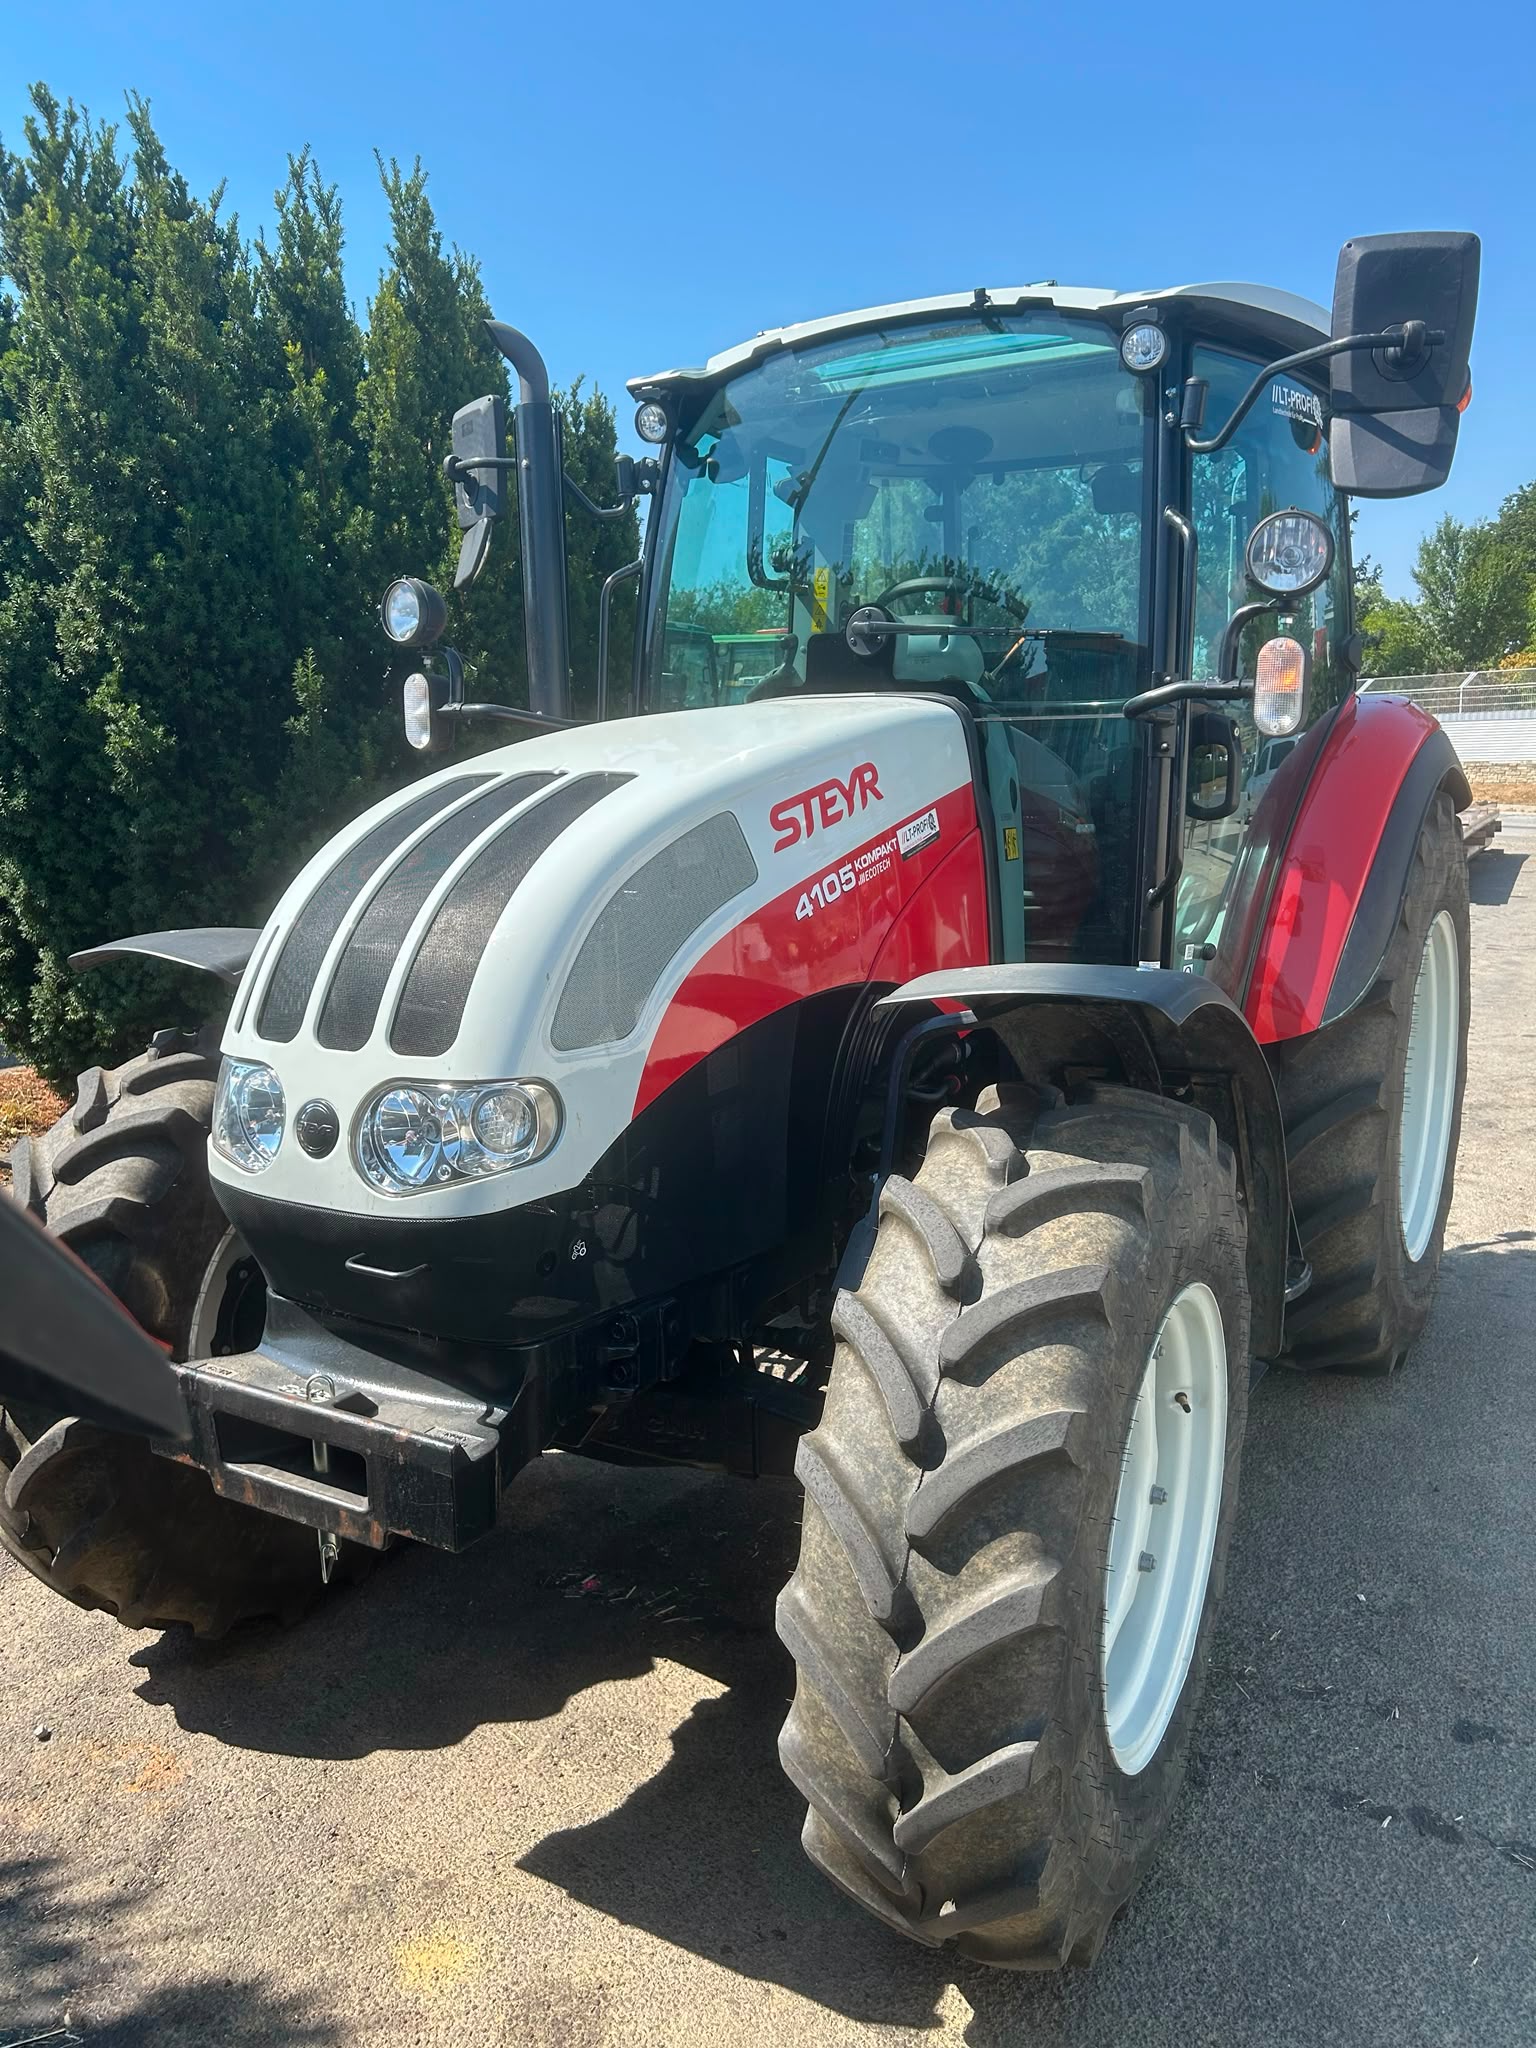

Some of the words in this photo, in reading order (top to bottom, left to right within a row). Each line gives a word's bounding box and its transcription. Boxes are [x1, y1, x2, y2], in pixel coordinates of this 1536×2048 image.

[769, 761, 884, 854] STEYR
[795, 863, 857, 922] 4105
[854, 837, 898, 872] KOMPAKT
